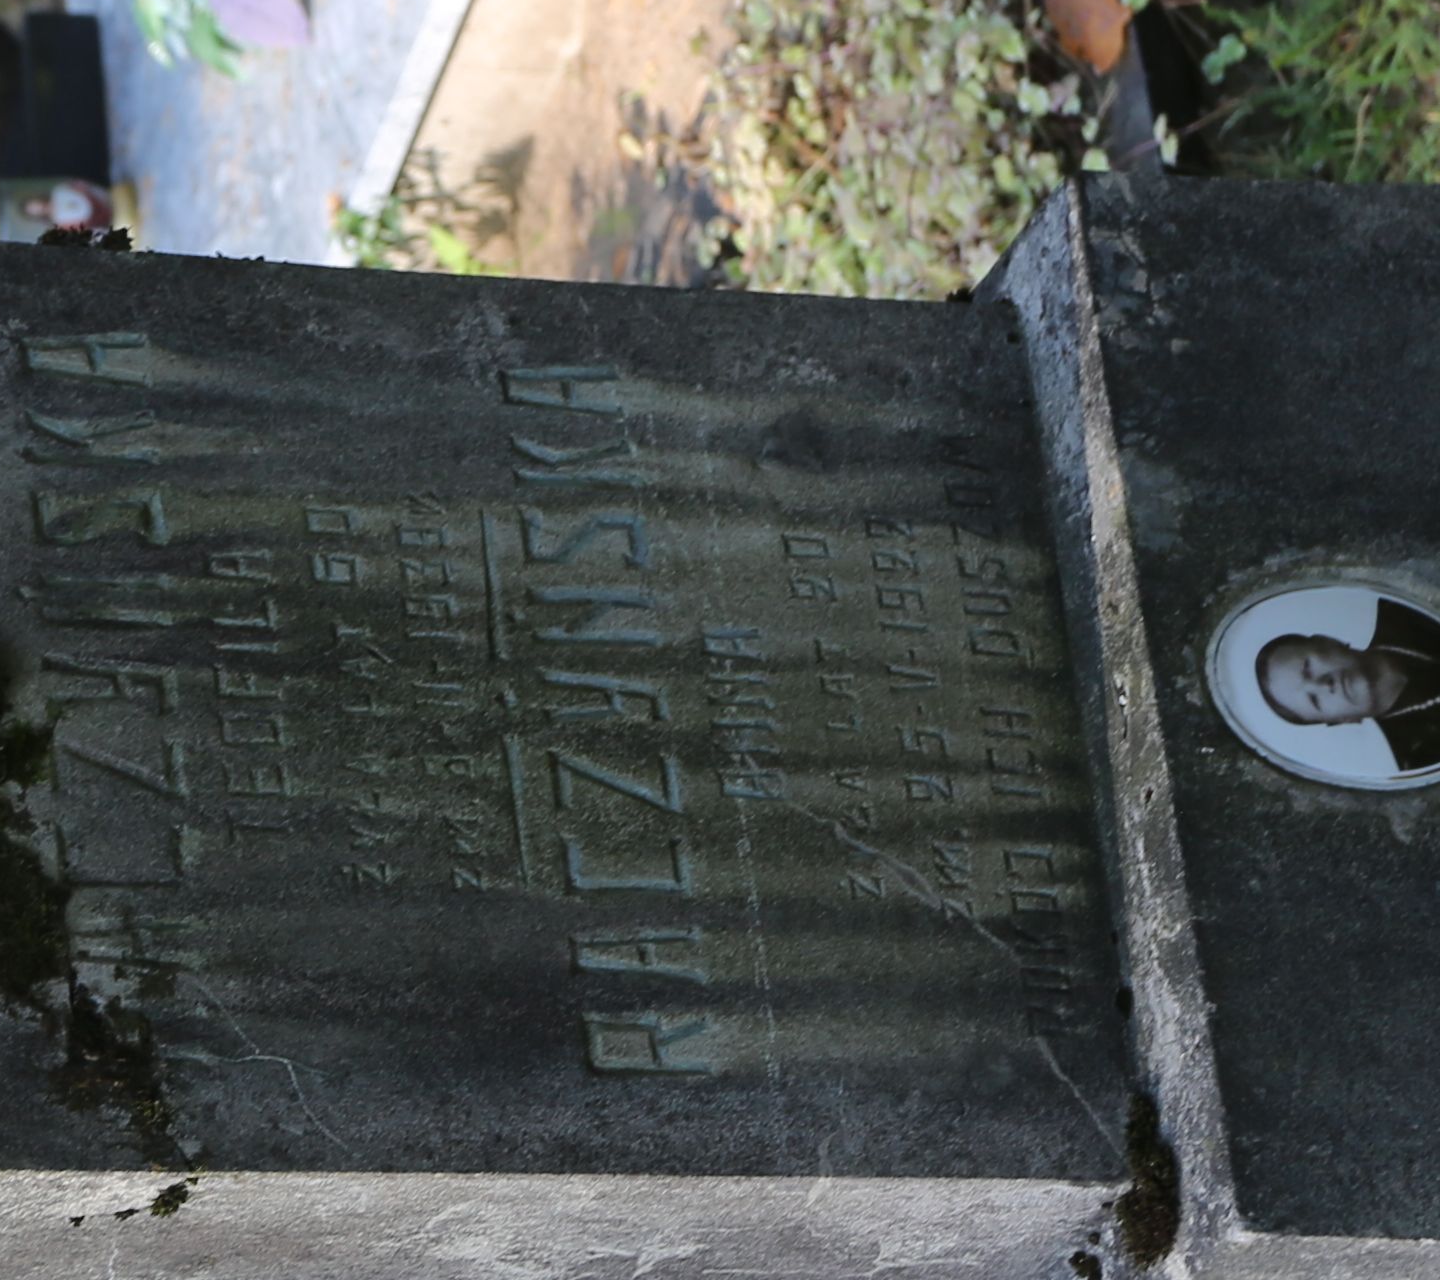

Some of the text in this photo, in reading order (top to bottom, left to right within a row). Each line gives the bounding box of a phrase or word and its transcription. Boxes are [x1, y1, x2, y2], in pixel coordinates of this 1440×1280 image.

[780, 532, 838, 604] 20
[938, 434, 1024, 663] DUSZOM
[495, 362, 720, 1080] RACZYŃSKA
[700, 624, 788, 800] ANNA
[813, 636, 862, 732] LAT
[982, 706, 1046, 798] ICH
